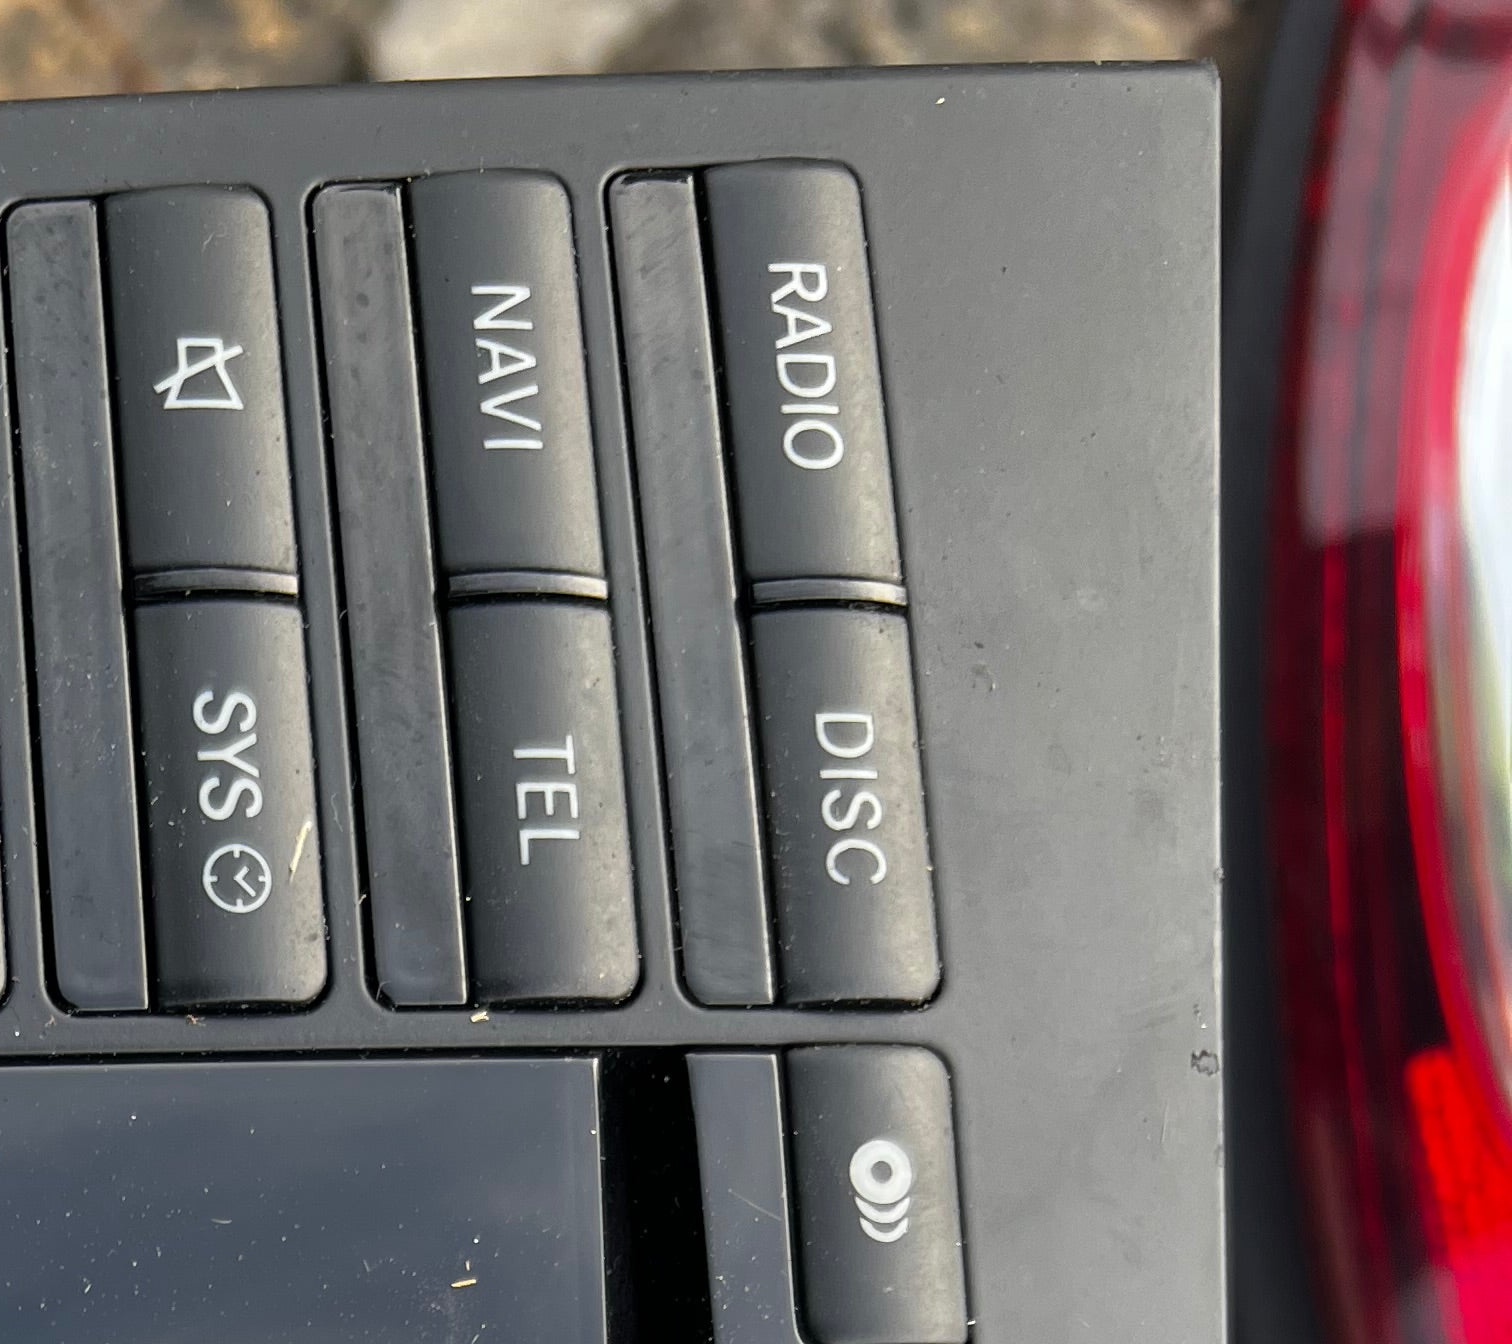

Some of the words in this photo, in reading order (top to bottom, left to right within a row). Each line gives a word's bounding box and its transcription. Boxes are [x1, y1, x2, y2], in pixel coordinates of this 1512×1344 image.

[472, 286, 542, 449] NAVI
[768, 263, 843, 469] RADIO
[193, 691, 262, 820] SYS
[514, 736, 579, 865] TEL
[816, 712, 886, 884] DISC
